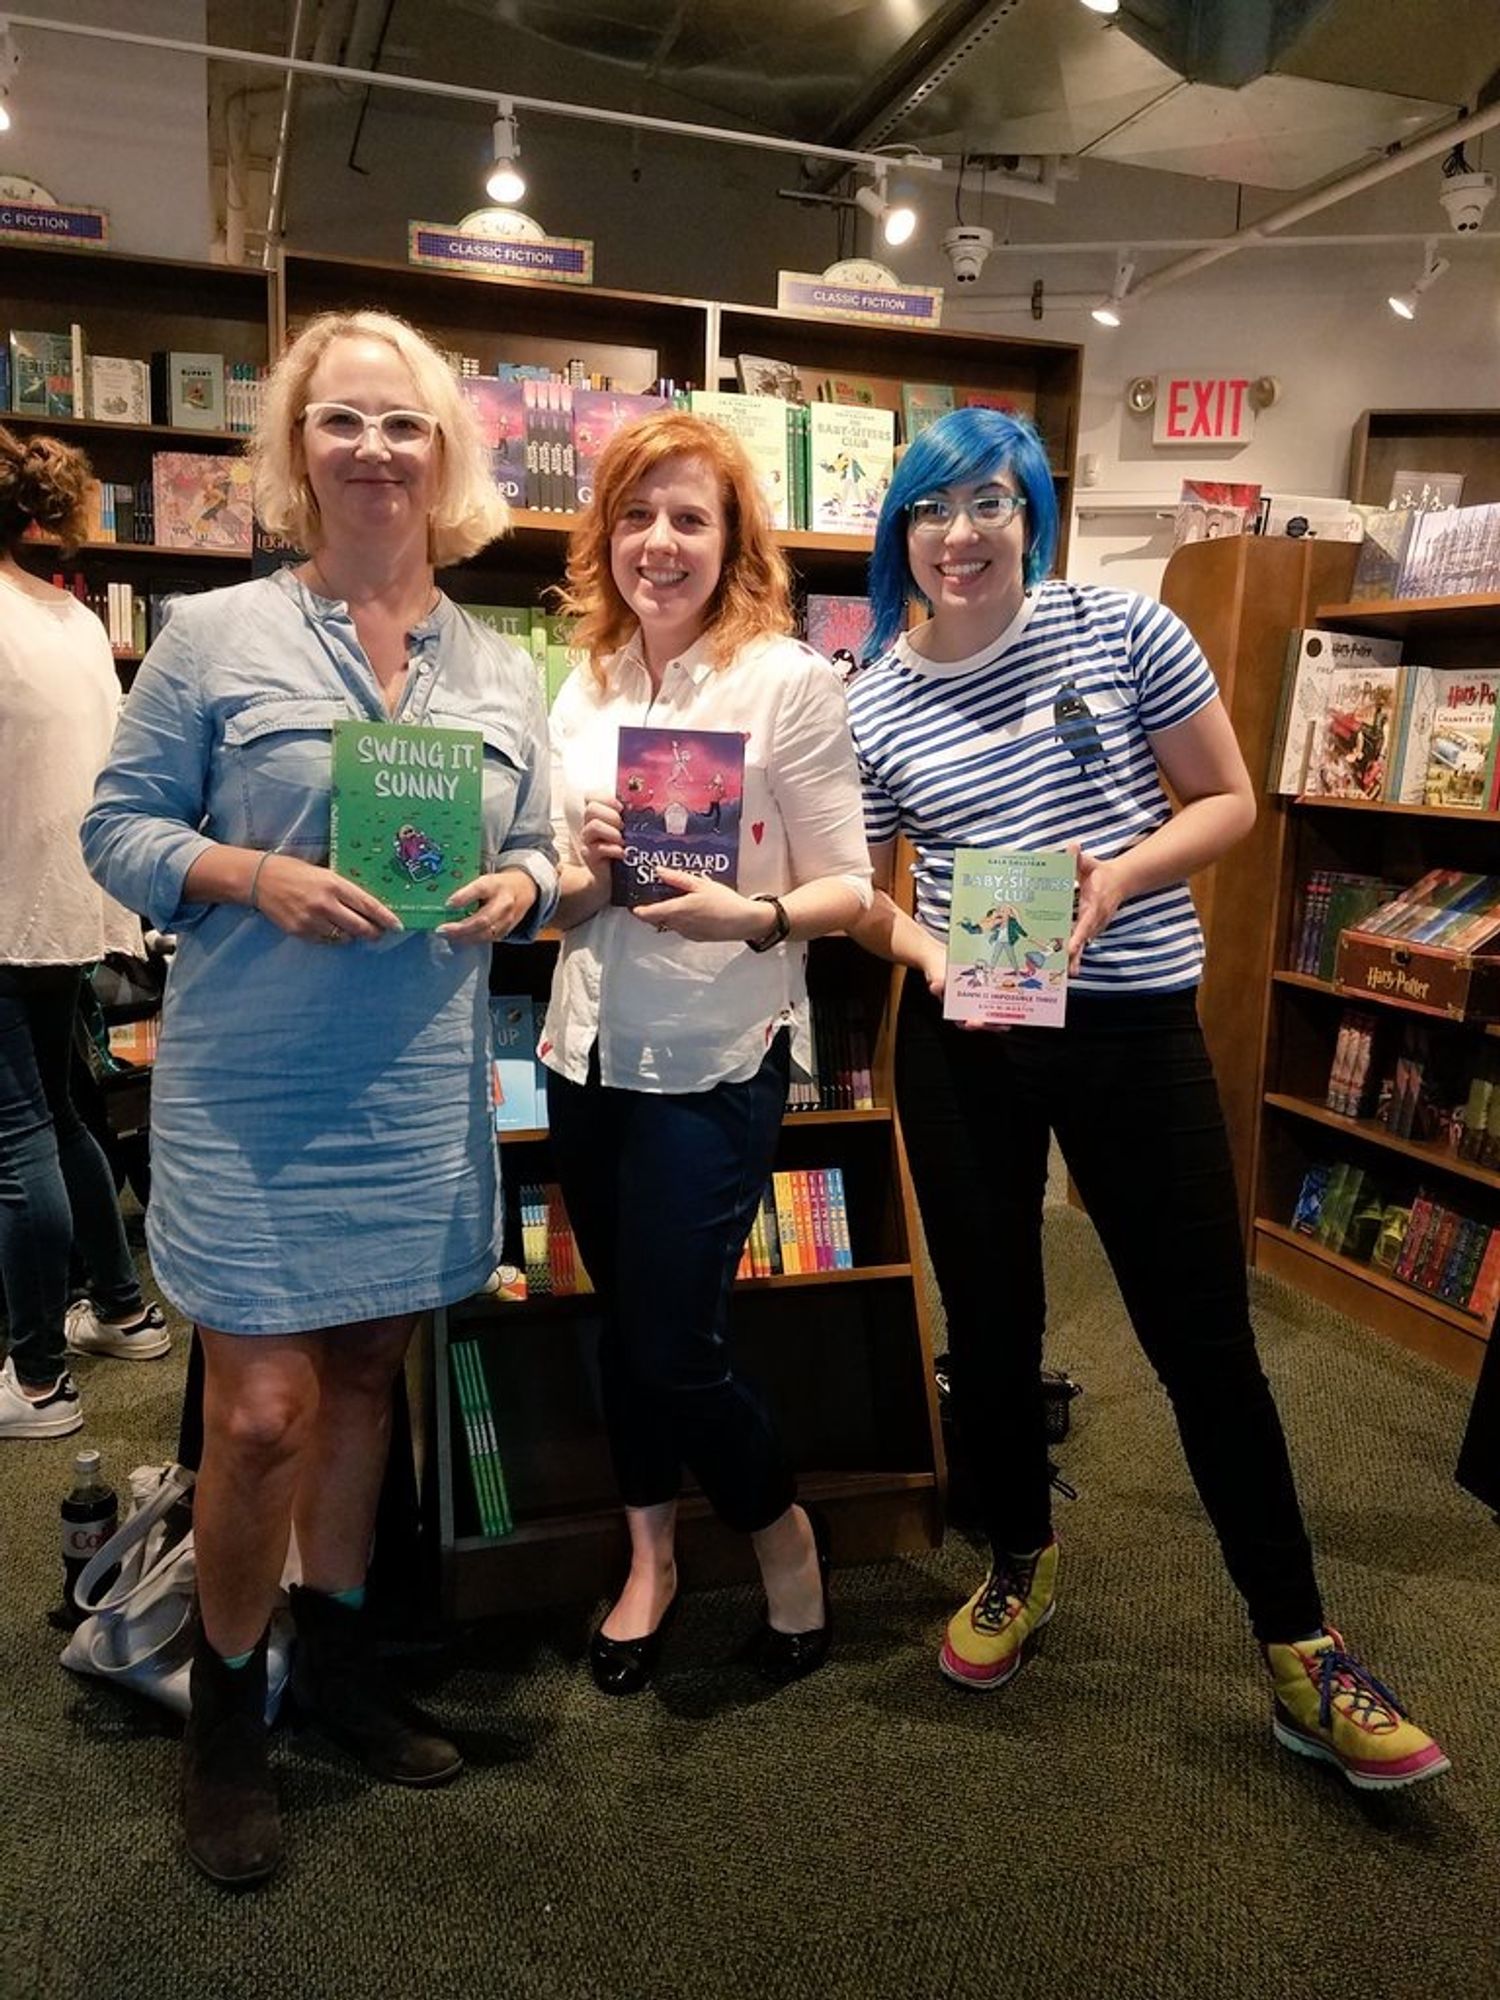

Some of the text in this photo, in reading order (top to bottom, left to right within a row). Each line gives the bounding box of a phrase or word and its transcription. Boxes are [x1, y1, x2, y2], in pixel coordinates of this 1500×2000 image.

[15, 213, 70, 230] FICTION
[449, 241, 555, 265] CLASSIC FICTION
[813, 290, 906, 310] CLASSIC FICTION
[1166, 380, 1249, 437] EXIT
[841, 437, 870, 449] CLUB
[1447, 685, 1478, 710] Harry
[357, 735, 479, 773] SWING IT,
[374, 769, 460, 801] SUNNY
[623, 845, 730, 872] GRAVEYARD
[962, 873, 1071, 892] BABY-SITTERS
[994, 888, 1035, 903] CLUB
[1366, 966, 1430, 1000] Harry Potter
[498, 1029, 520, 1047] UP
